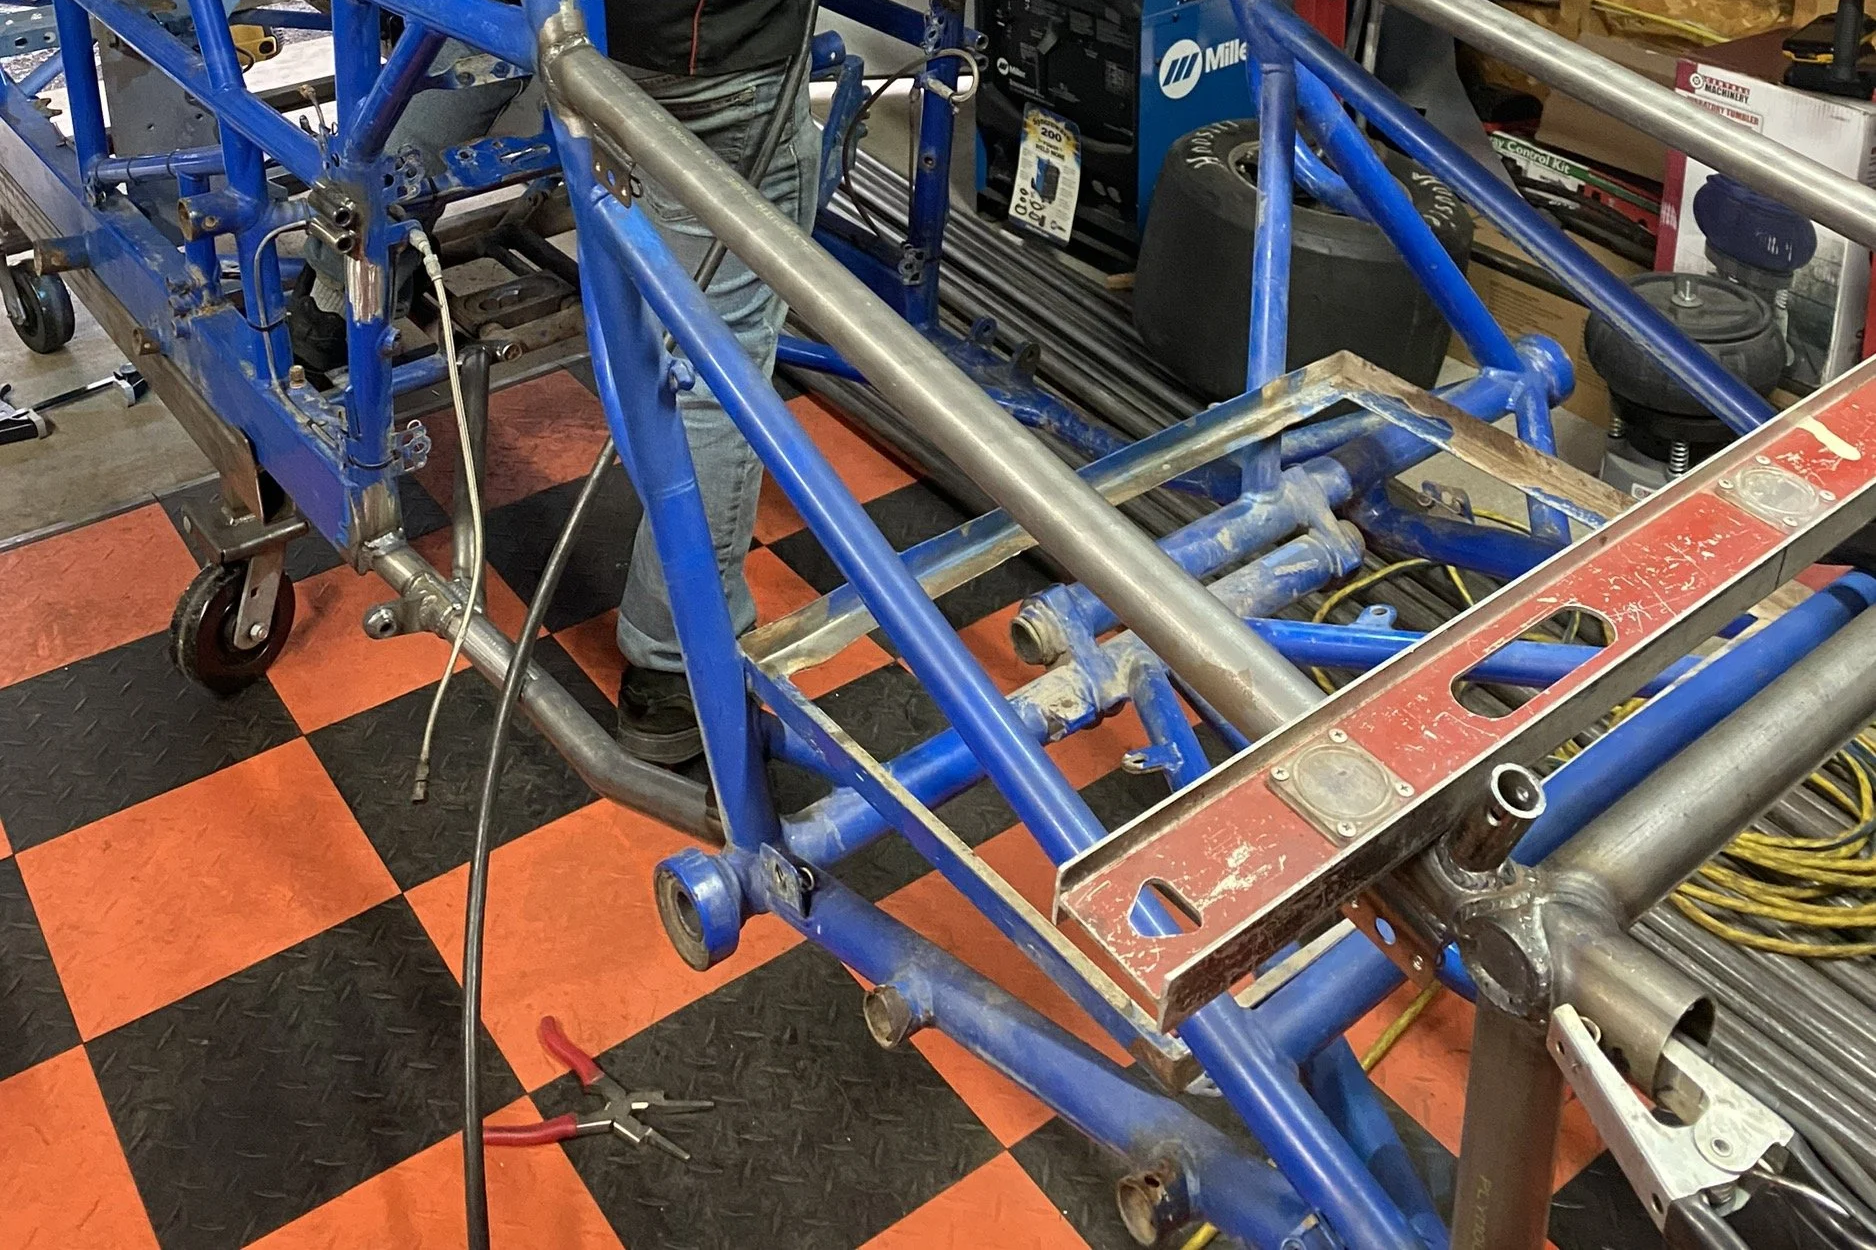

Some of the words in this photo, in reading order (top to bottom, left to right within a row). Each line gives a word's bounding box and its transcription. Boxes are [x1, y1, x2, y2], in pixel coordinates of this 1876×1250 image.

[1205, 39, 1247, 74] Mille
[1704, 84, 1749, 104] MACHINERY
[1040, 127, 1062, 143] 200
[1507, 141, 1549, 166] Control
[1552, 158, 1571, 174] Kit
